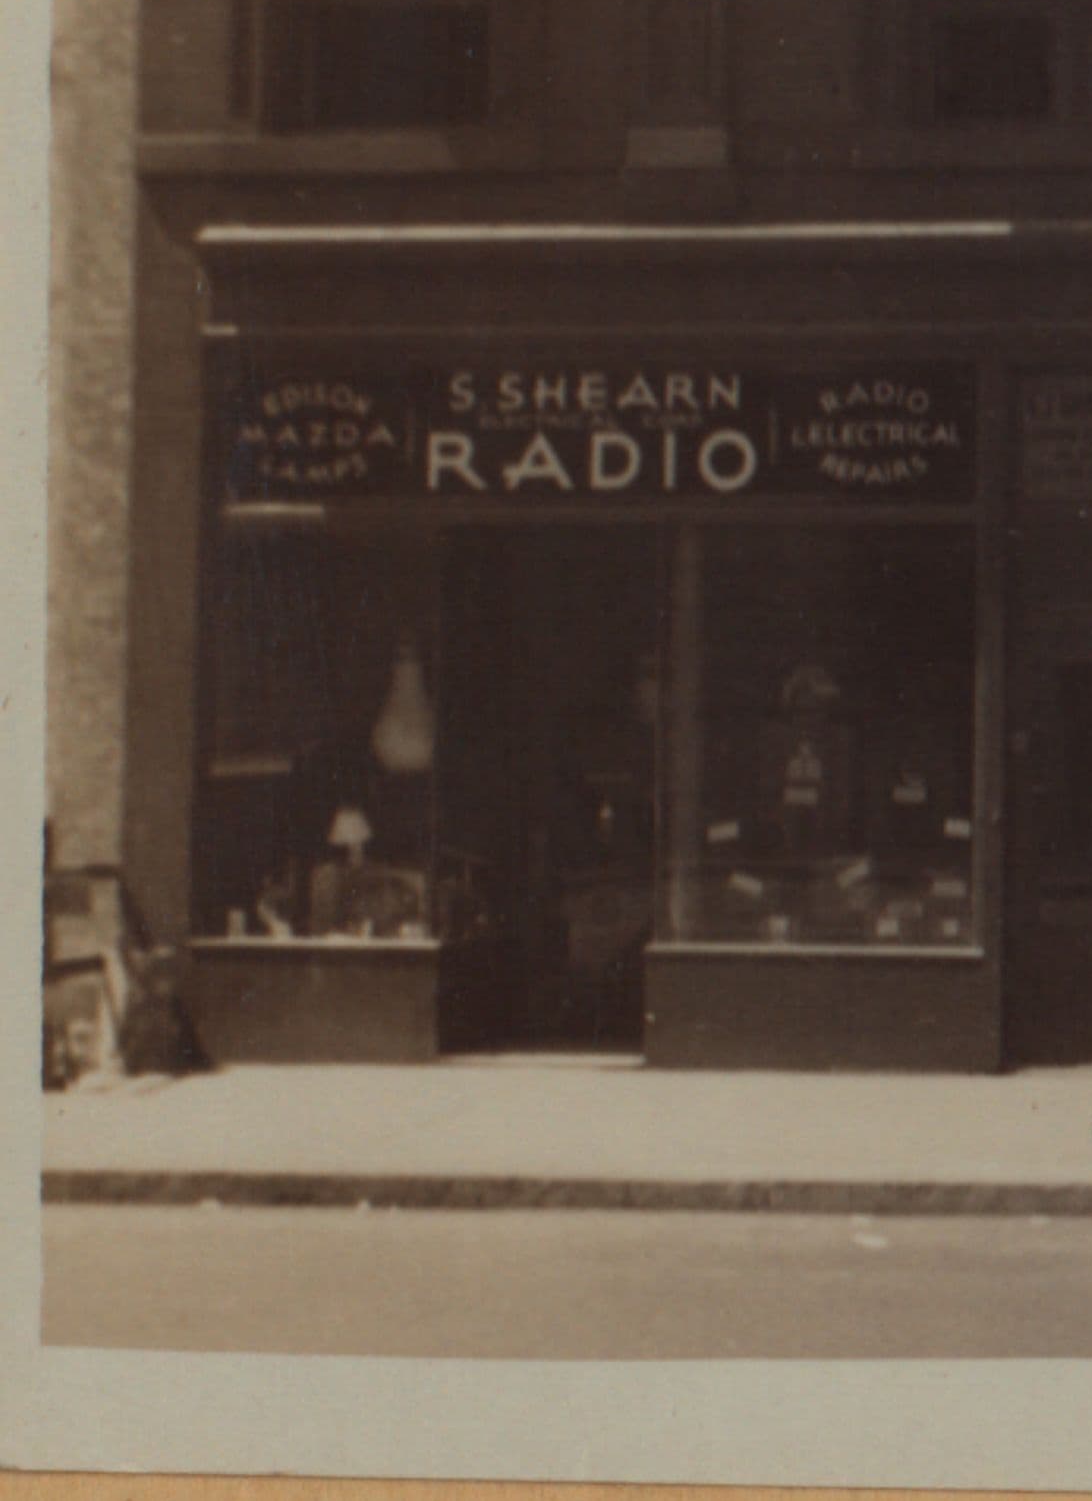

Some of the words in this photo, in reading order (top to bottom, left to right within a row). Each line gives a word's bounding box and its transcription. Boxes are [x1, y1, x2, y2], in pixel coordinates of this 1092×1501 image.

[496, 370, 742, 412] SHEARN
[817, 379, 931, 415] RADIO
[237, 419, 397, 448] MAZDA
[426, 426, 759, 493] RADIO
